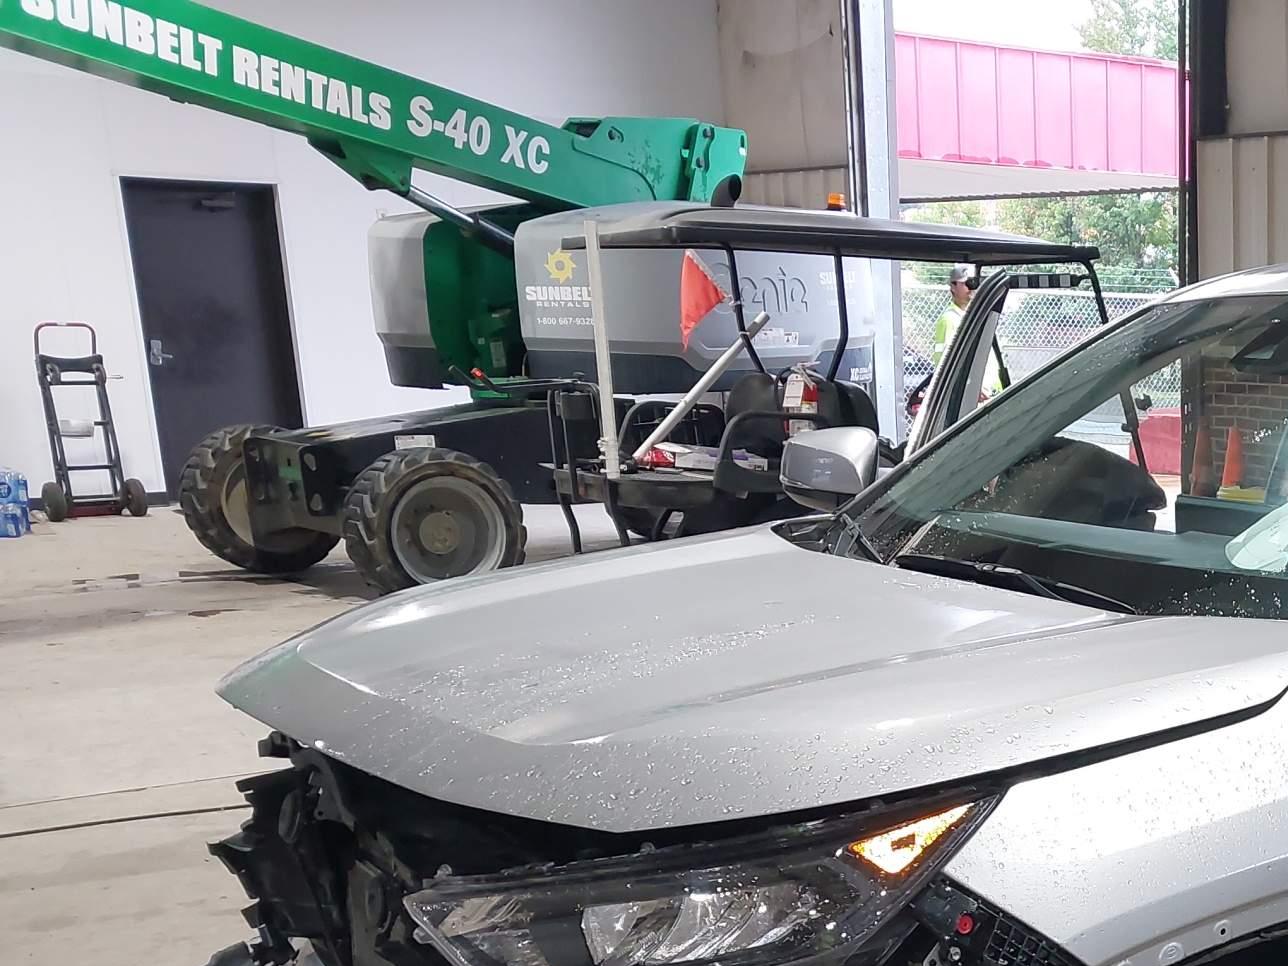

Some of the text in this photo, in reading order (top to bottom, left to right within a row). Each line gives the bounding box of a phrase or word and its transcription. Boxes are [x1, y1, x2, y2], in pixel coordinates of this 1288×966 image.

[233, 46, 391, 130] RENTALS
[407, 96, 550, 174] S-40 XC
[525, 286, 592, 301] SUNBEL
[536, 317, 557, 325] 1-800
